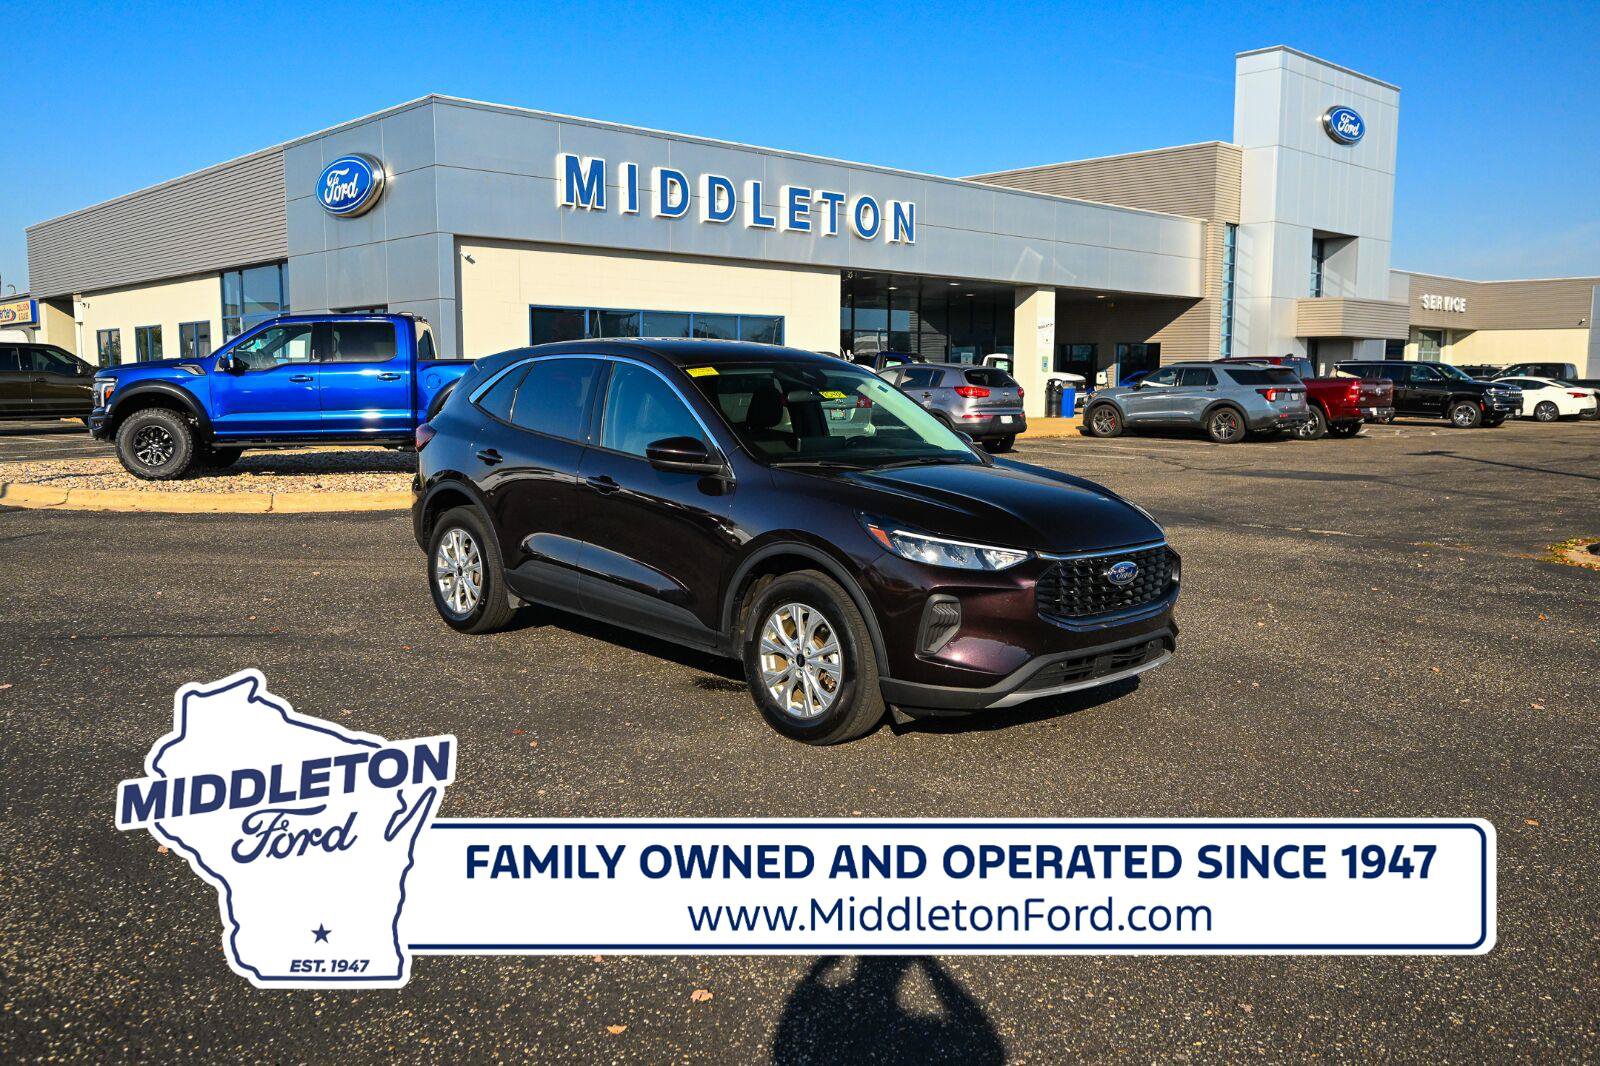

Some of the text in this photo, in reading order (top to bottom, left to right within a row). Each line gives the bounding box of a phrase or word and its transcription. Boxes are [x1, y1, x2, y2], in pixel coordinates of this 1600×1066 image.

[1337, 112, 1360, 136] Ford
[324, 168, 359, 204] Ford
[557, 153, 916, 244] MIDDLETON
[1422, 294, 1467, 312] SERVICE
